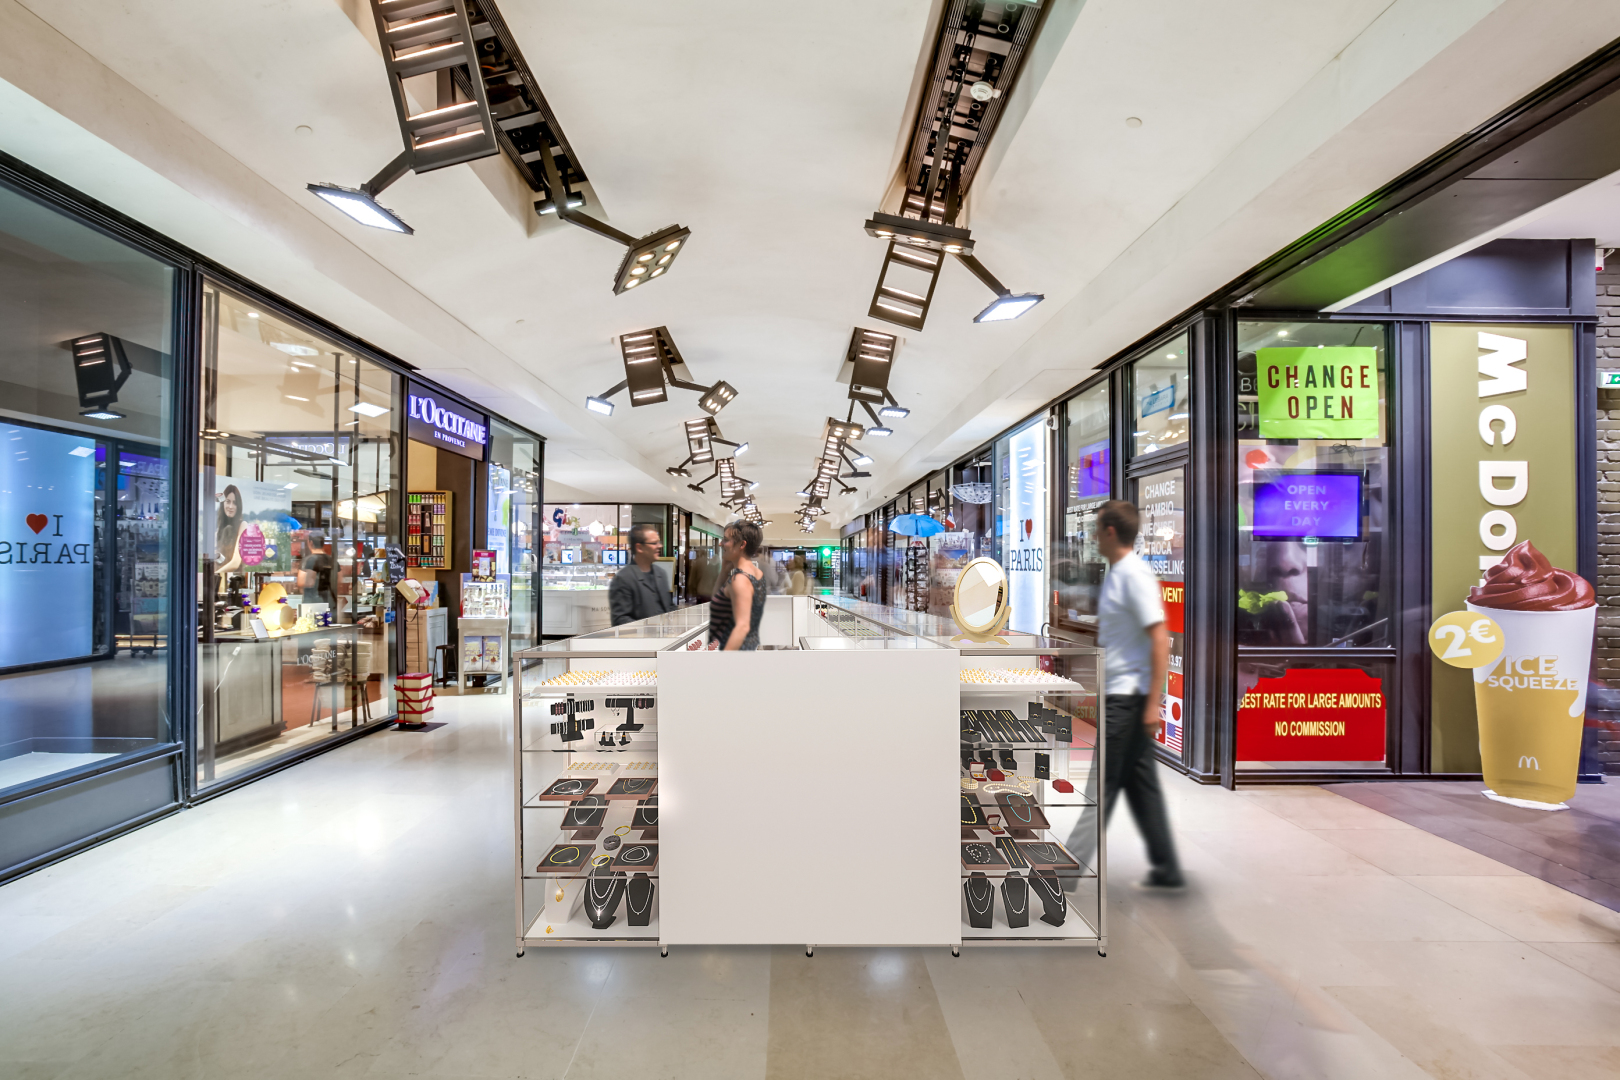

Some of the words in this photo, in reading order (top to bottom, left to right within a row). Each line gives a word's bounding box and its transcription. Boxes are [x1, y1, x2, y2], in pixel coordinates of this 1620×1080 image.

[1267, 365, 1370, 388] CHANGE
[1288, 396, 1354, 419] OPEN
[409, 395, 486, 444] L'OCCITANE
[434, 431, 441, 439] EN
[442, 433, 466, 448] PROVENCE
[1145, 481, 1176, 499] CHANGE
[1287, 485, 1326, 495] OPEN
[1145, 500, 1174, 518] CAMBIO
[1284, 500, 1329, 510] EVERY
[1291, 516, 1321, 526] DAY
[1019, 519, 1024, 542] I
[1147, 541, 1172, 556] TROCA
[1010, 547, 1043, 573] PARIS
[1162, 587, 1183, 603] VENT
[1435, 619, 1496, 659] 2€
[1505, 655, 1558, 675] ICE
[1488, 675, 1579, 691] SQUEEZE
[1239, 693, 1262, 708] BEST
[1263, 693, 1286, 708] RATE
[1287, 693, 1306, 708] FOR
[1308, 693, 1337, 708] LARGE
[1338, 693, 1381, 708] AMOUNTS
[1275, 721, 1288, 736] NO
[1290, 721, 1345, 736] COMMISSION
